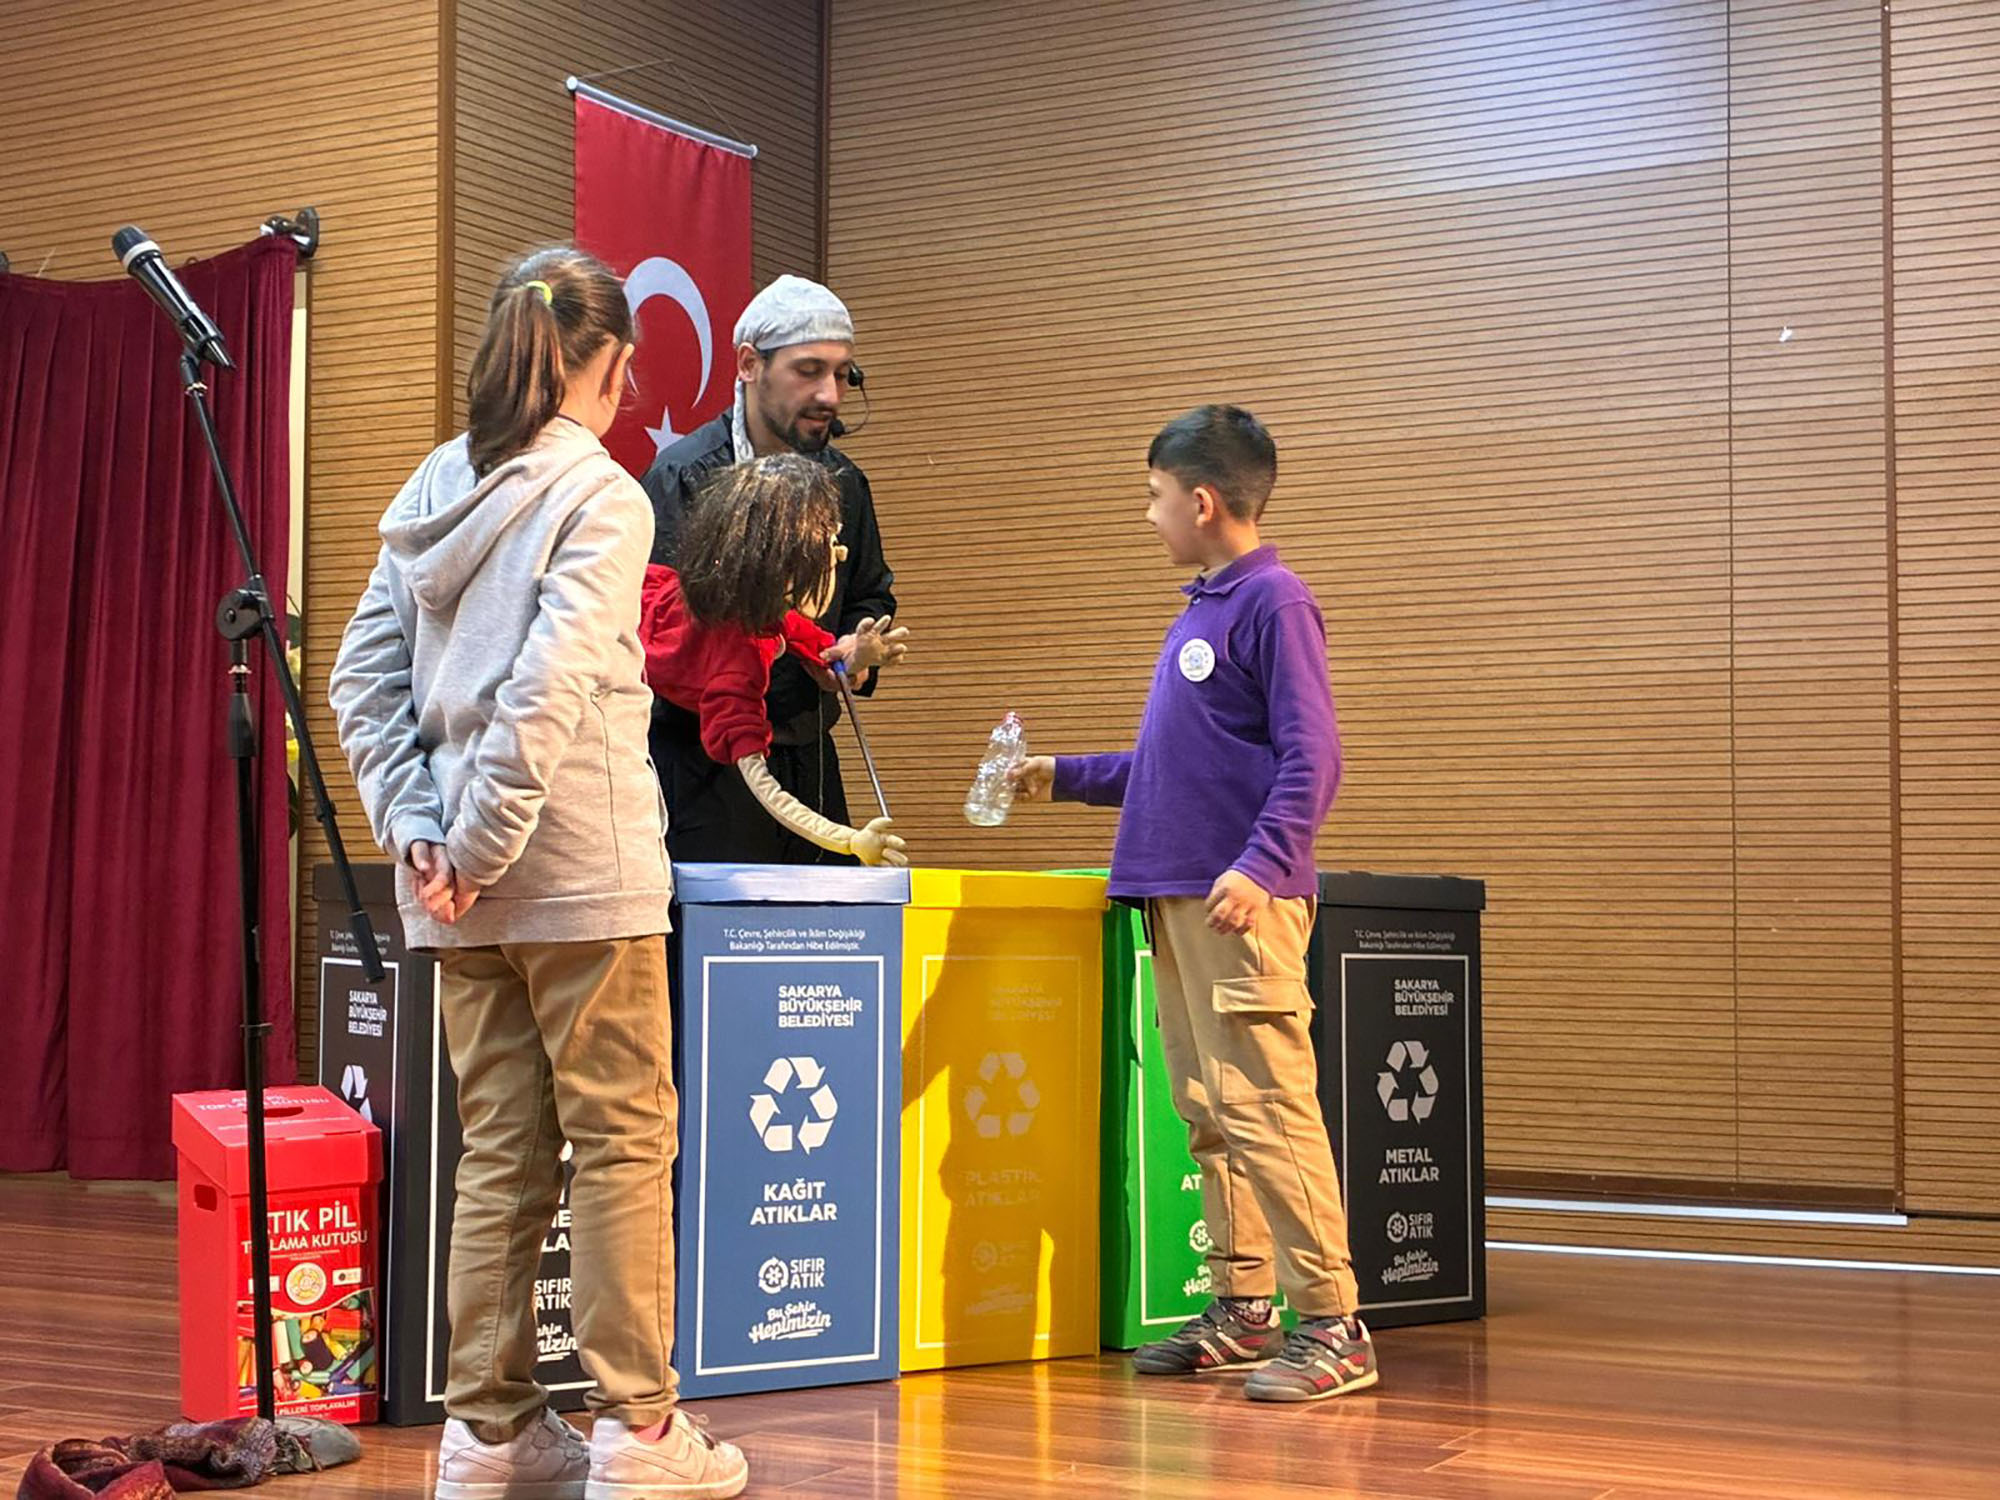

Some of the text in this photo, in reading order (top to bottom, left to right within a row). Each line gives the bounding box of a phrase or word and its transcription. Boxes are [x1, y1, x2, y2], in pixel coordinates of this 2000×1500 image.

[798, 930, 807, 938] ve
[778, 985, 842, 998] SAKARYA
[1394, 979, 1440, 991] SAKARYA
[778, 996, 863, 1013] BÜYÜKŞEHİR
[1394, 989, 1455, 1004] BÜYÜKŞEHİR
[1394, 1001, 1449, 1016] BELEDİYESİ
[778, 1011, 854, 1028] BELEDİYESİ
[1386, 1147, 1433, 1164] METAL
[1379, 1166, 1440, 1184] ATIKLAR
[763, 1178, 826, 1201] KAĞIT
[267, 1200, 357, 1235] TIK PİL
[750, 1203, 837, 1225] ATIKLAR
[1409, 1212, 1433, 1226] SIFIR
[1409, 1225, 1433, 1239] ATIK
[241, 1230, 368, 1254] TLAMA KUTUSU
[790, 1258, 825, 1273] SIFIR
[534, 1277, 572, 1294] SIFIR
[790, 1272, 825, 1289] ATIK
[535, 1293, 572, 1310] ATIK
[767, 1301, 817, 1321] Bu Şehir
[749, 1311, 832, 1344] Hepimizin
